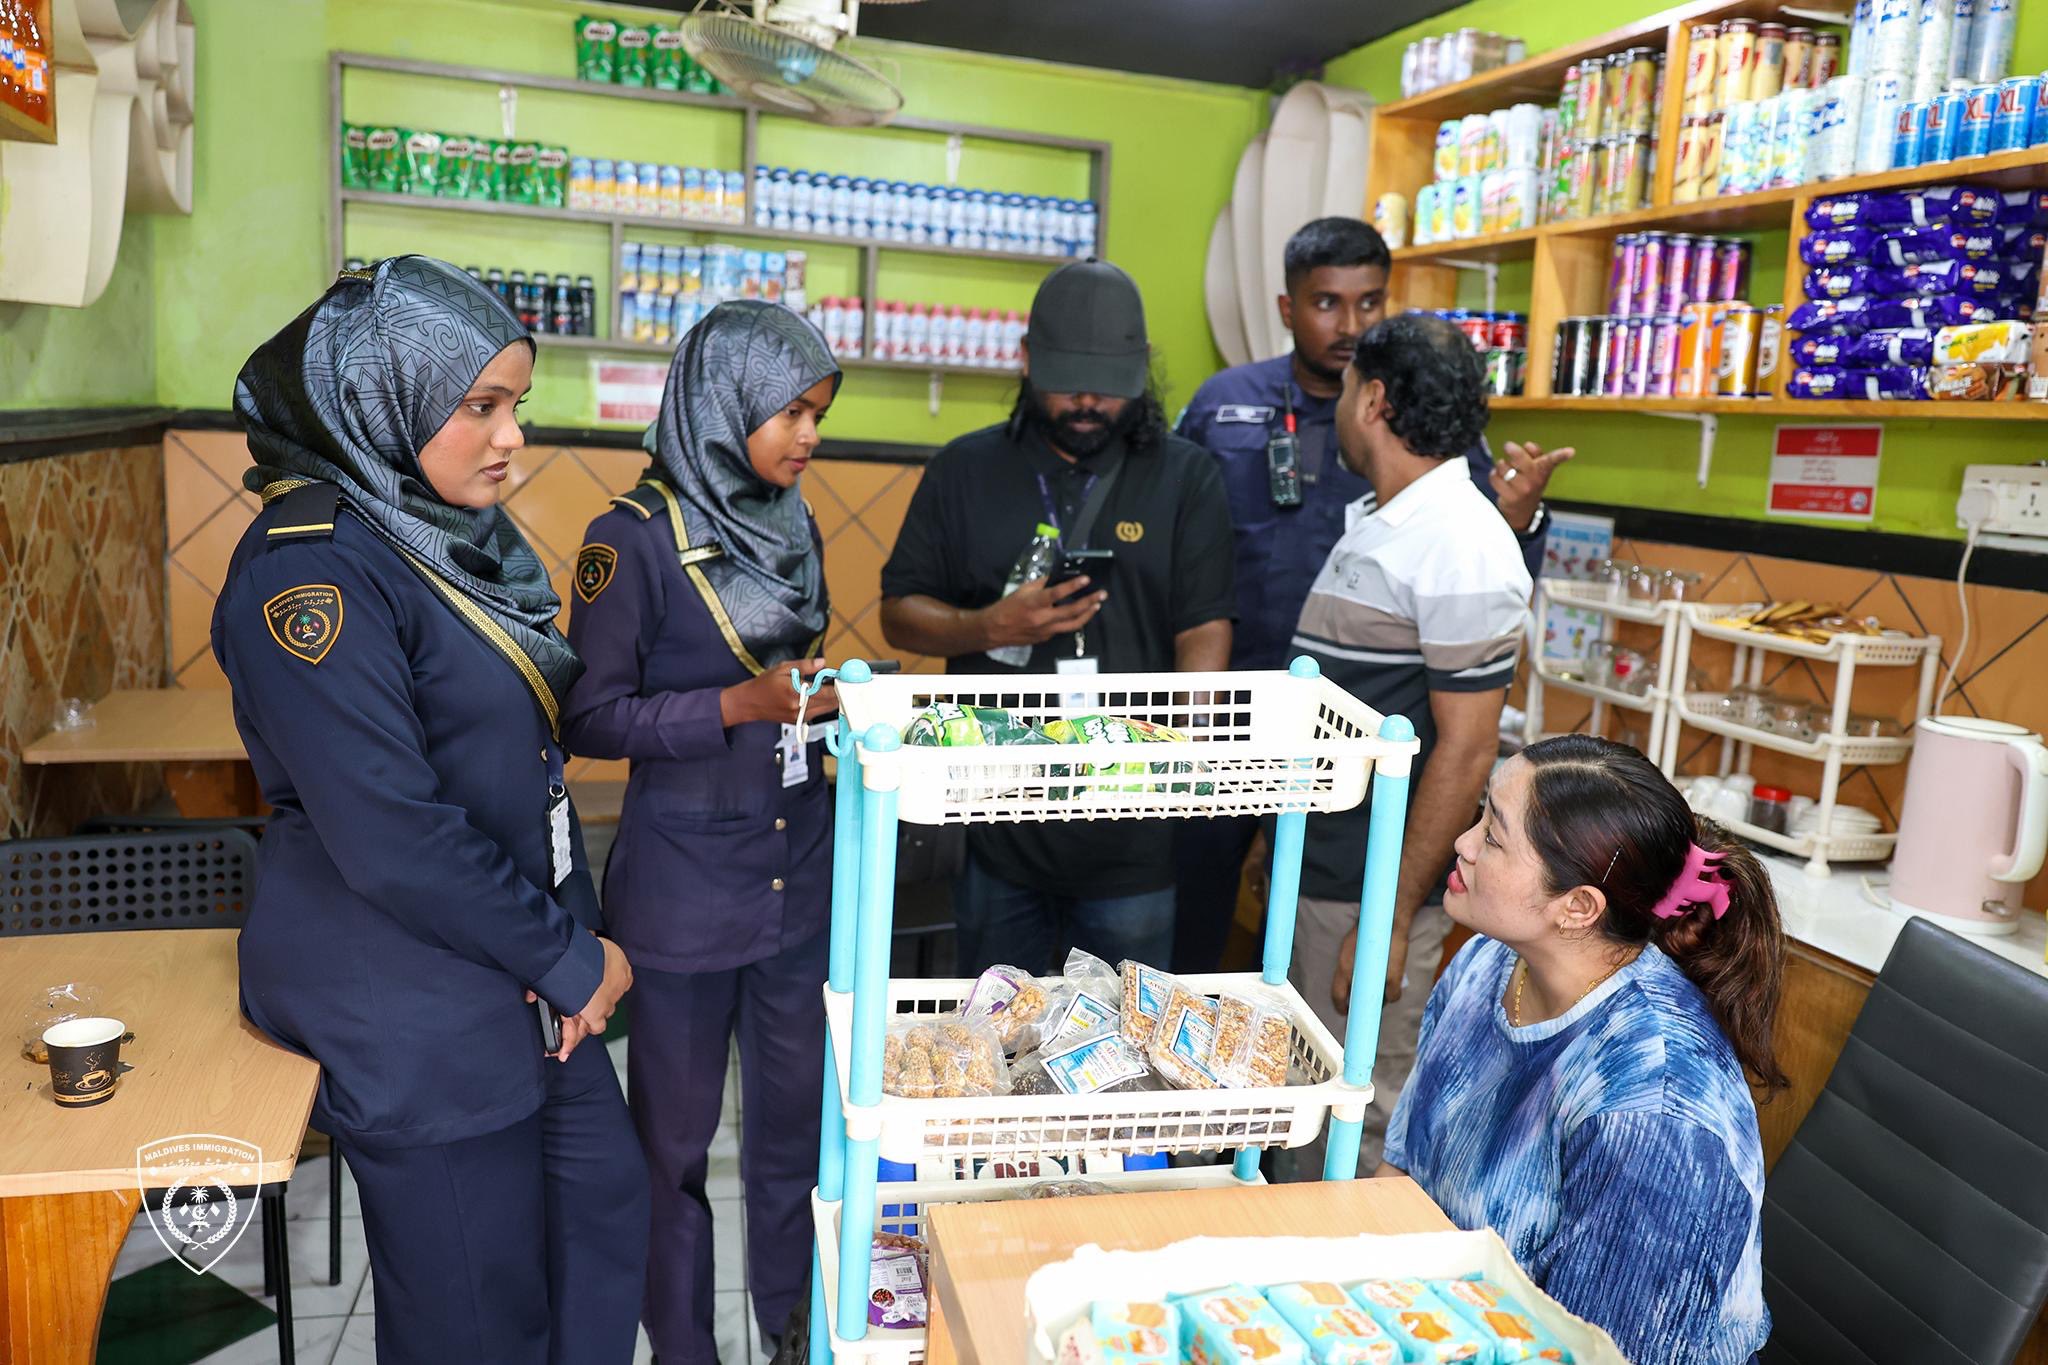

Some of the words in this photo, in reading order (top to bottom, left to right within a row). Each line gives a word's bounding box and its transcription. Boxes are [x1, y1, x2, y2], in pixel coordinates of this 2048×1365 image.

[1964, 96, 1991, 122] XL
[1998, 89, 2024, 114] XL
[1898, 111, 1917, 133] XL
[1927, 104, 1943, 128] XL
[269, 596, 294, 613] MALDIVES
[294, 591, 334, 600] IMMIGRATION
